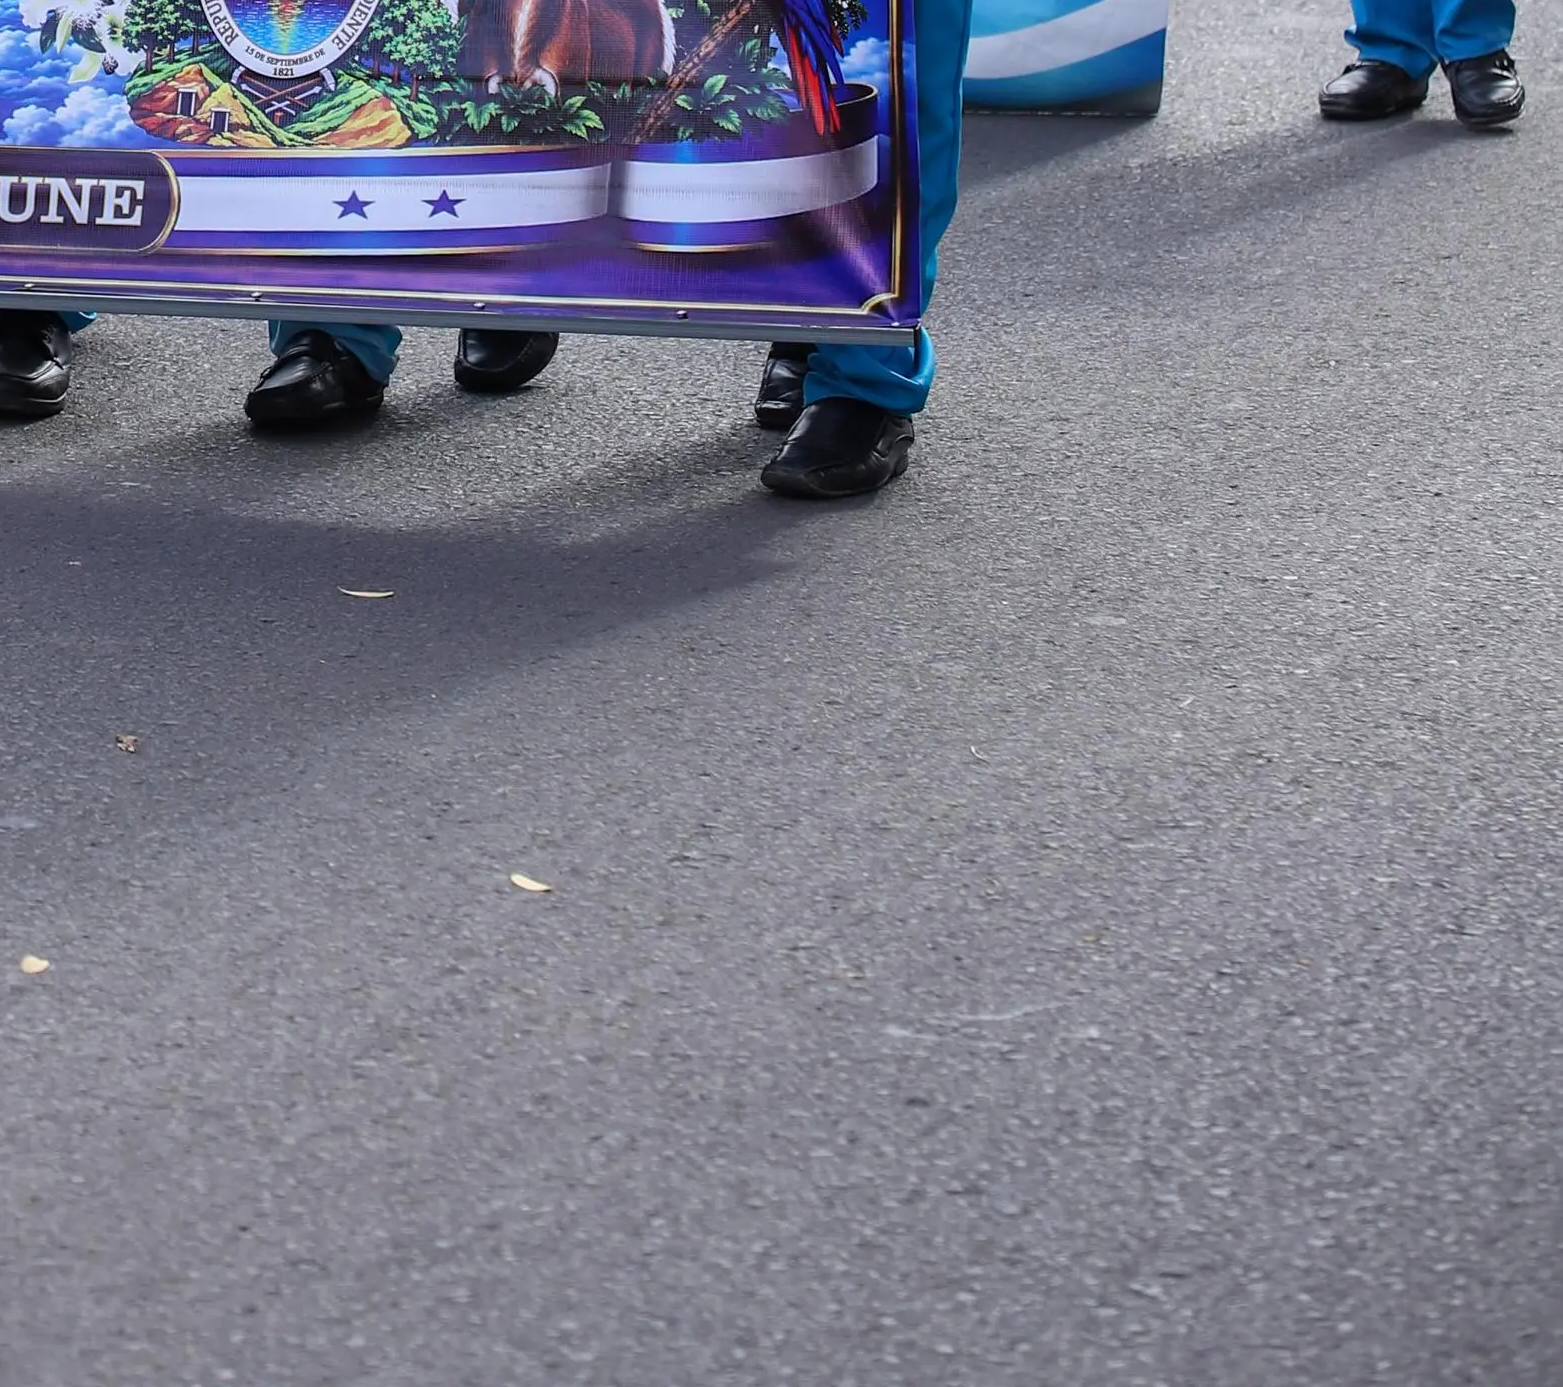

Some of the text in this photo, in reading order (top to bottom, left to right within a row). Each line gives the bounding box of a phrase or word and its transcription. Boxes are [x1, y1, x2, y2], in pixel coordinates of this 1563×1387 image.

[255, 51, 266, 61] DE
[266, 54, 313, 66] SEPTIEMBRE
[314, 48, 326, 59] DE
[273, 68, 294, 76] 1821
